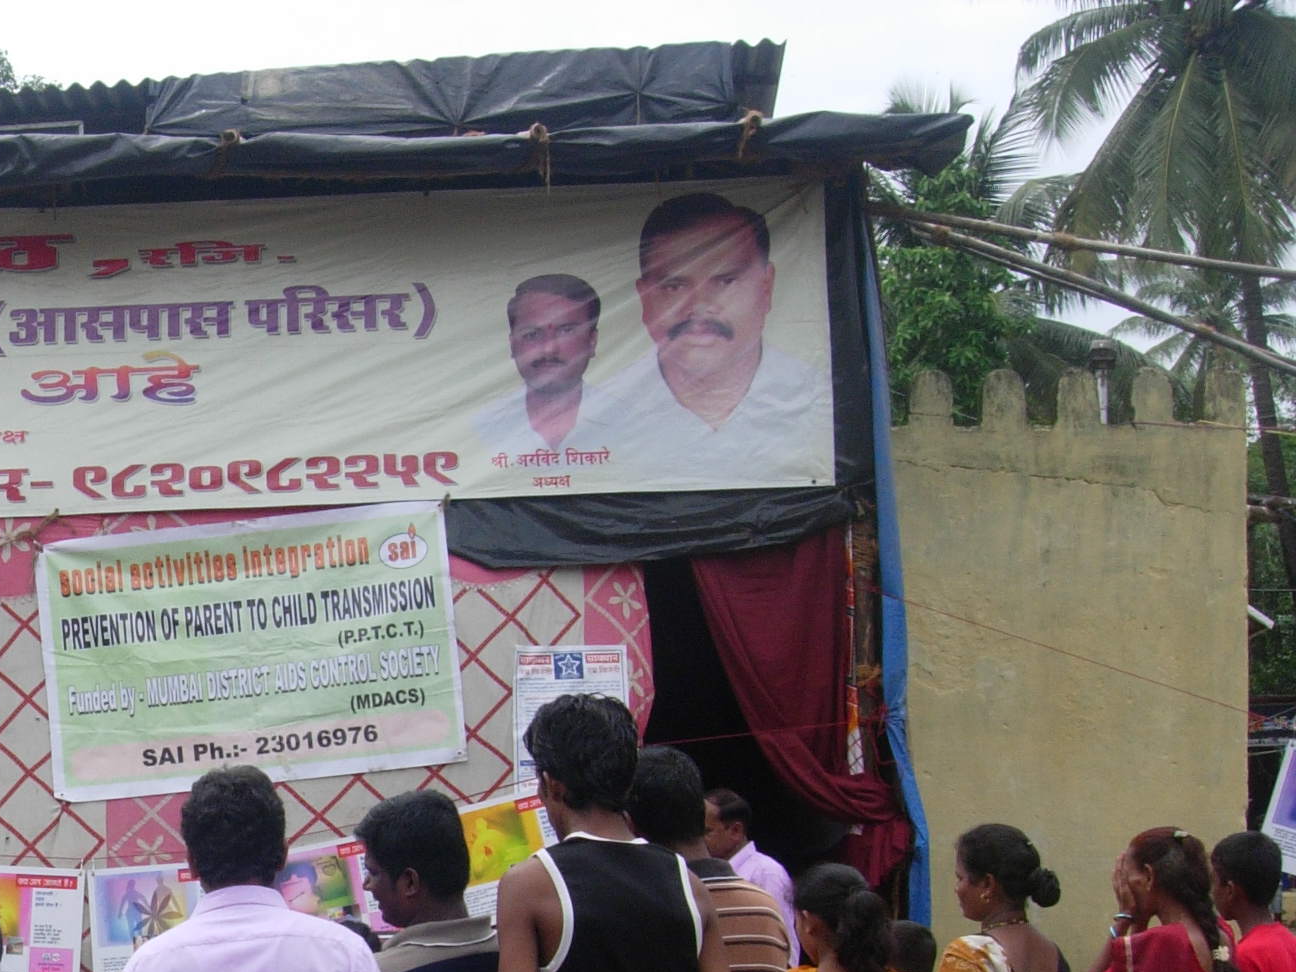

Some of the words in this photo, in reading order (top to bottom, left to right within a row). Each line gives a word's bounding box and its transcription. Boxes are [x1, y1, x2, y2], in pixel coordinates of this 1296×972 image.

[246, 281, 438, 341] परिसर)
[21, 350, 201, 405] आहे
[129, 549, 238, 590] activities
[242, 535, 370, 578] integration
[387, 534, 418, 563] sai
[60, 613, 155, 651] PREVENTION
[160, 607, 181, 641] OF
[184, 600, 243, 636] PARENT
[247, 596, 268, 631] TO
[272, 590, 317, 629] CHILD
[320, 575, 437, 622] TRANSMISSION
[337, 620, 425, 649] (P.P.T.C.T.)
[67, 685, 117, 717] Funded
[120, 681, 137, 718] by
[145, 667, 204, 709] MUMBAI
[207, 660, 273, 702] DISTRICT
[275, 658, 306, 694] AIDS
[309, 652, 377, 690] CONTROL
[379, 645, 441, 682] SOCIETY
[350, 688, 426, 714] (MDACS)
[142, 748, 184, 767] SAI
[255, 724, 379, 756] 23016976
